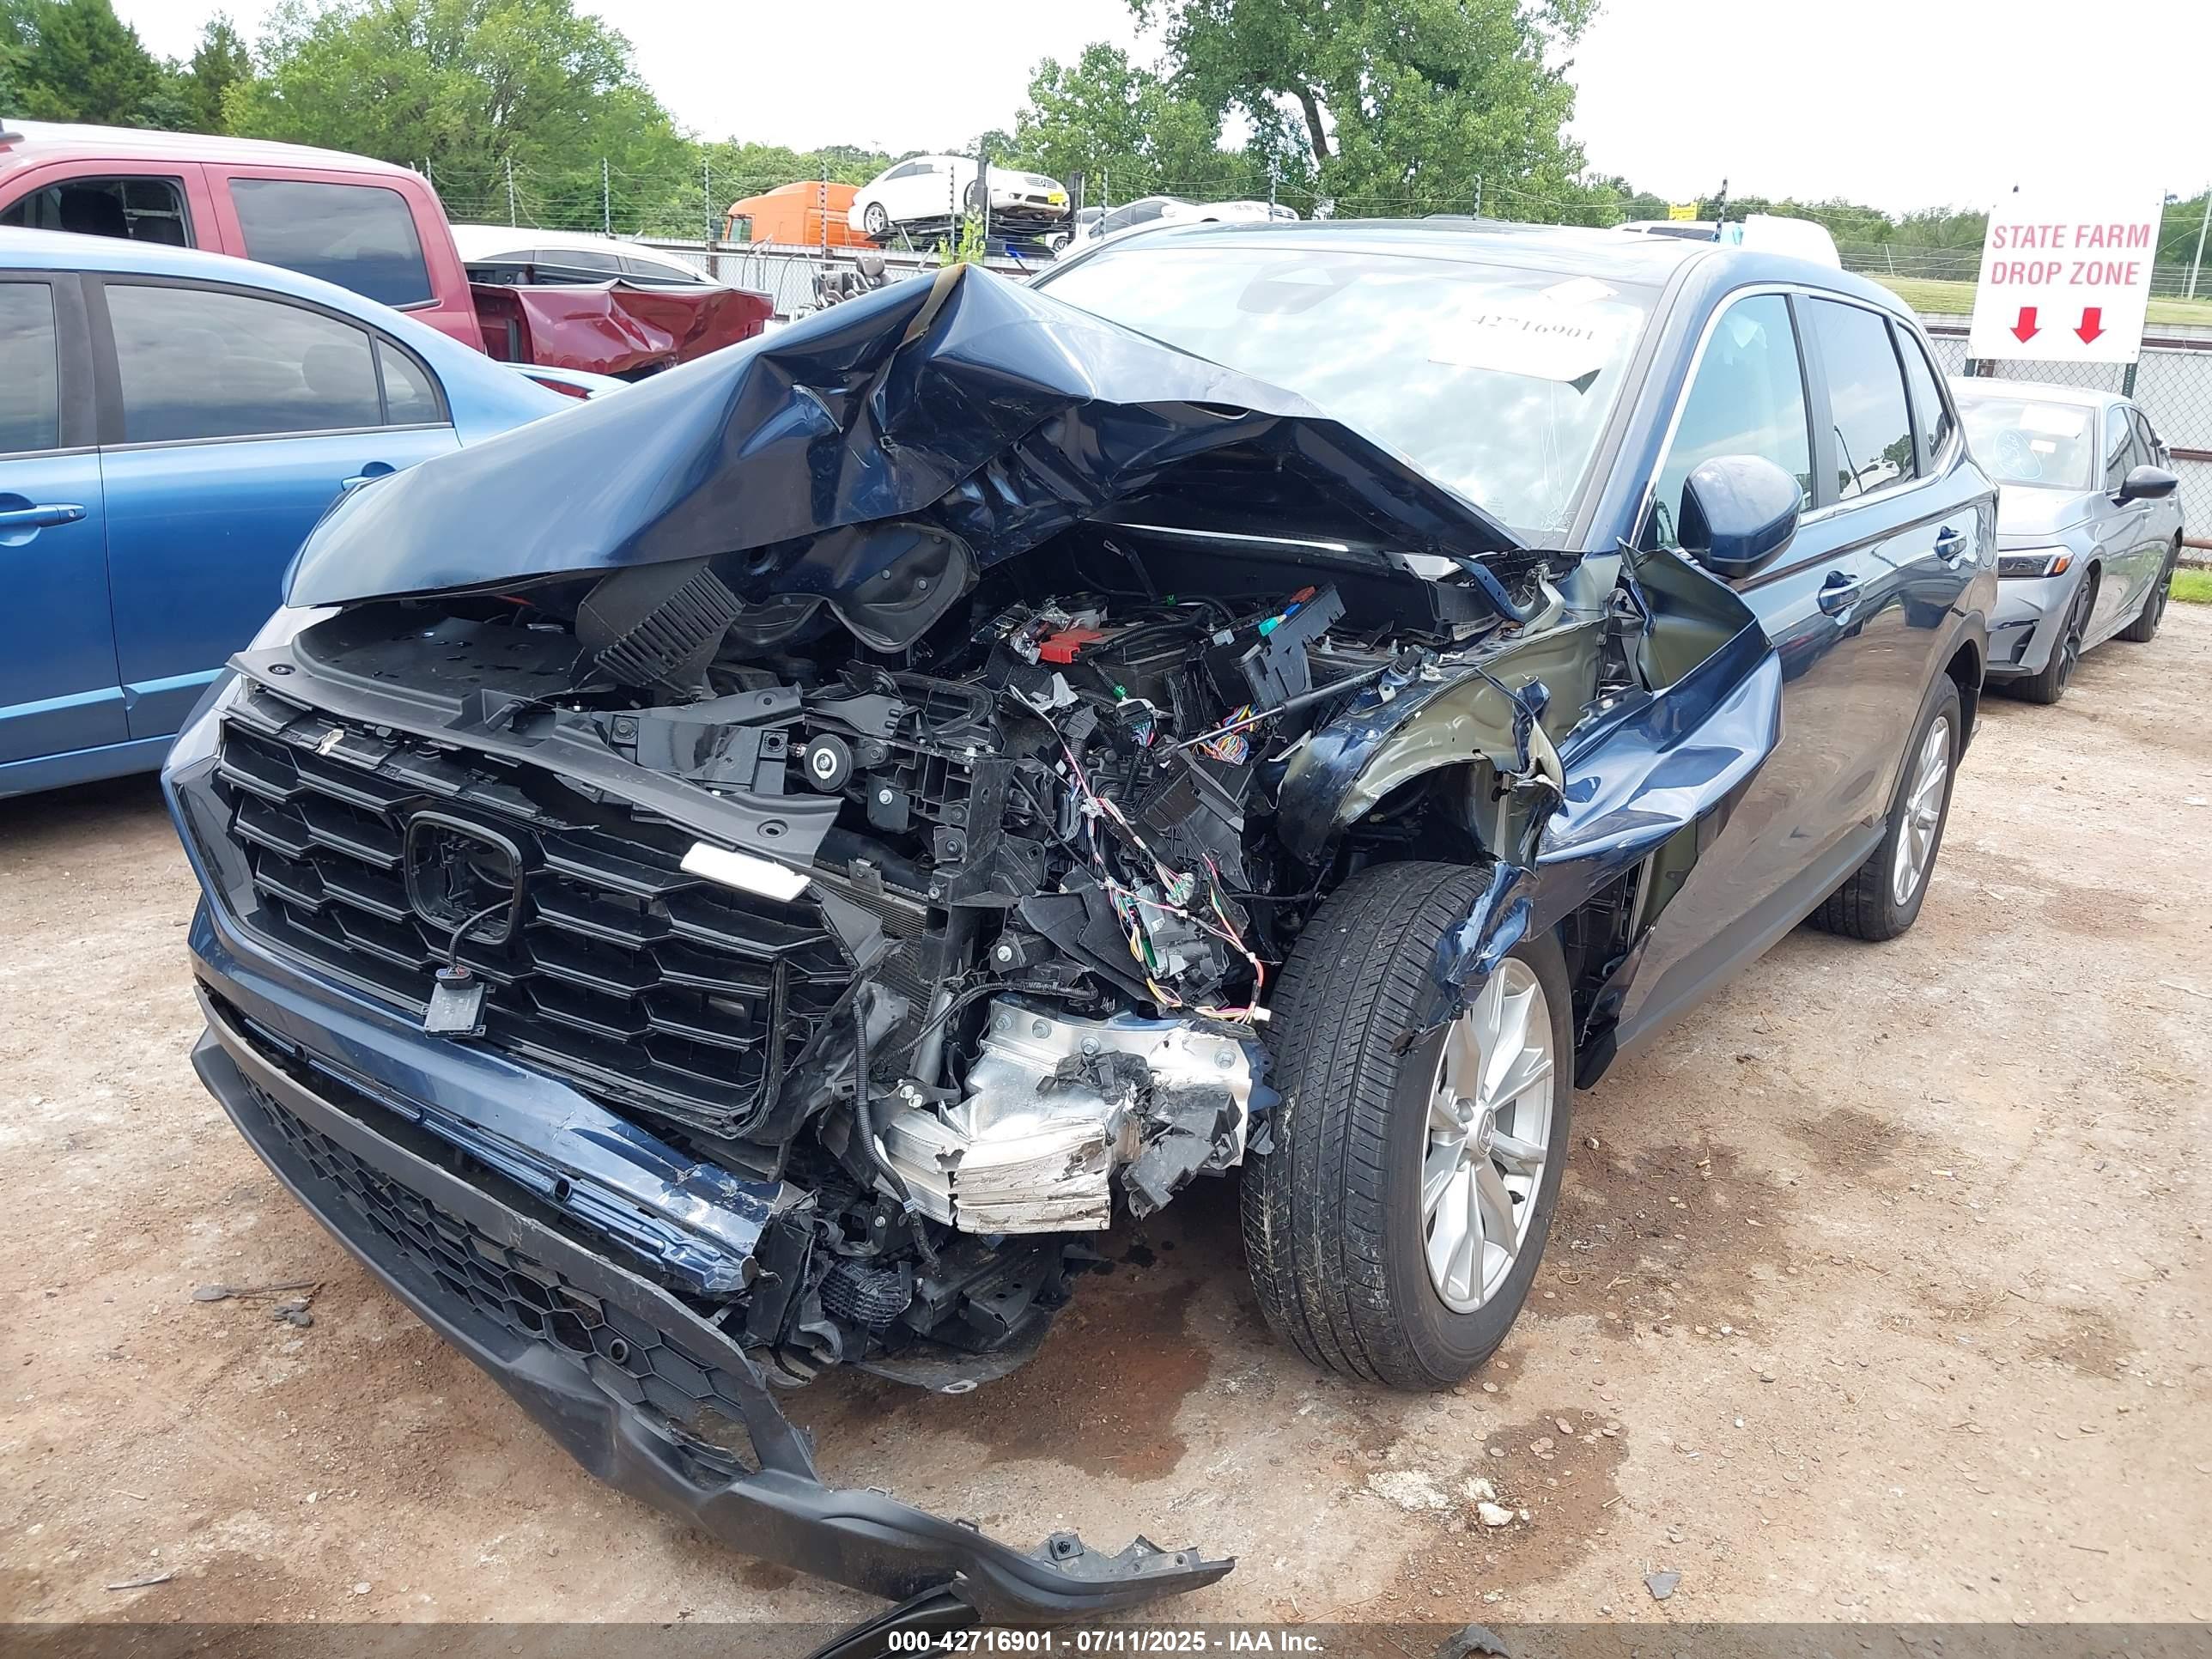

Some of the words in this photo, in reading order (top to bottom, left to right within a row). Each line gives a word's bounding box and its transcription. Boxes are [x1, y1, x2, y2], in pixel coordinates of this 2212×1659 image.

[1992, 224, 2067, 249] STATE
[2075, 223, 2150, 249] FARM
[1990, 261, 2063, 285] DROP
[2069, 261, 2141, 286] ZONE
